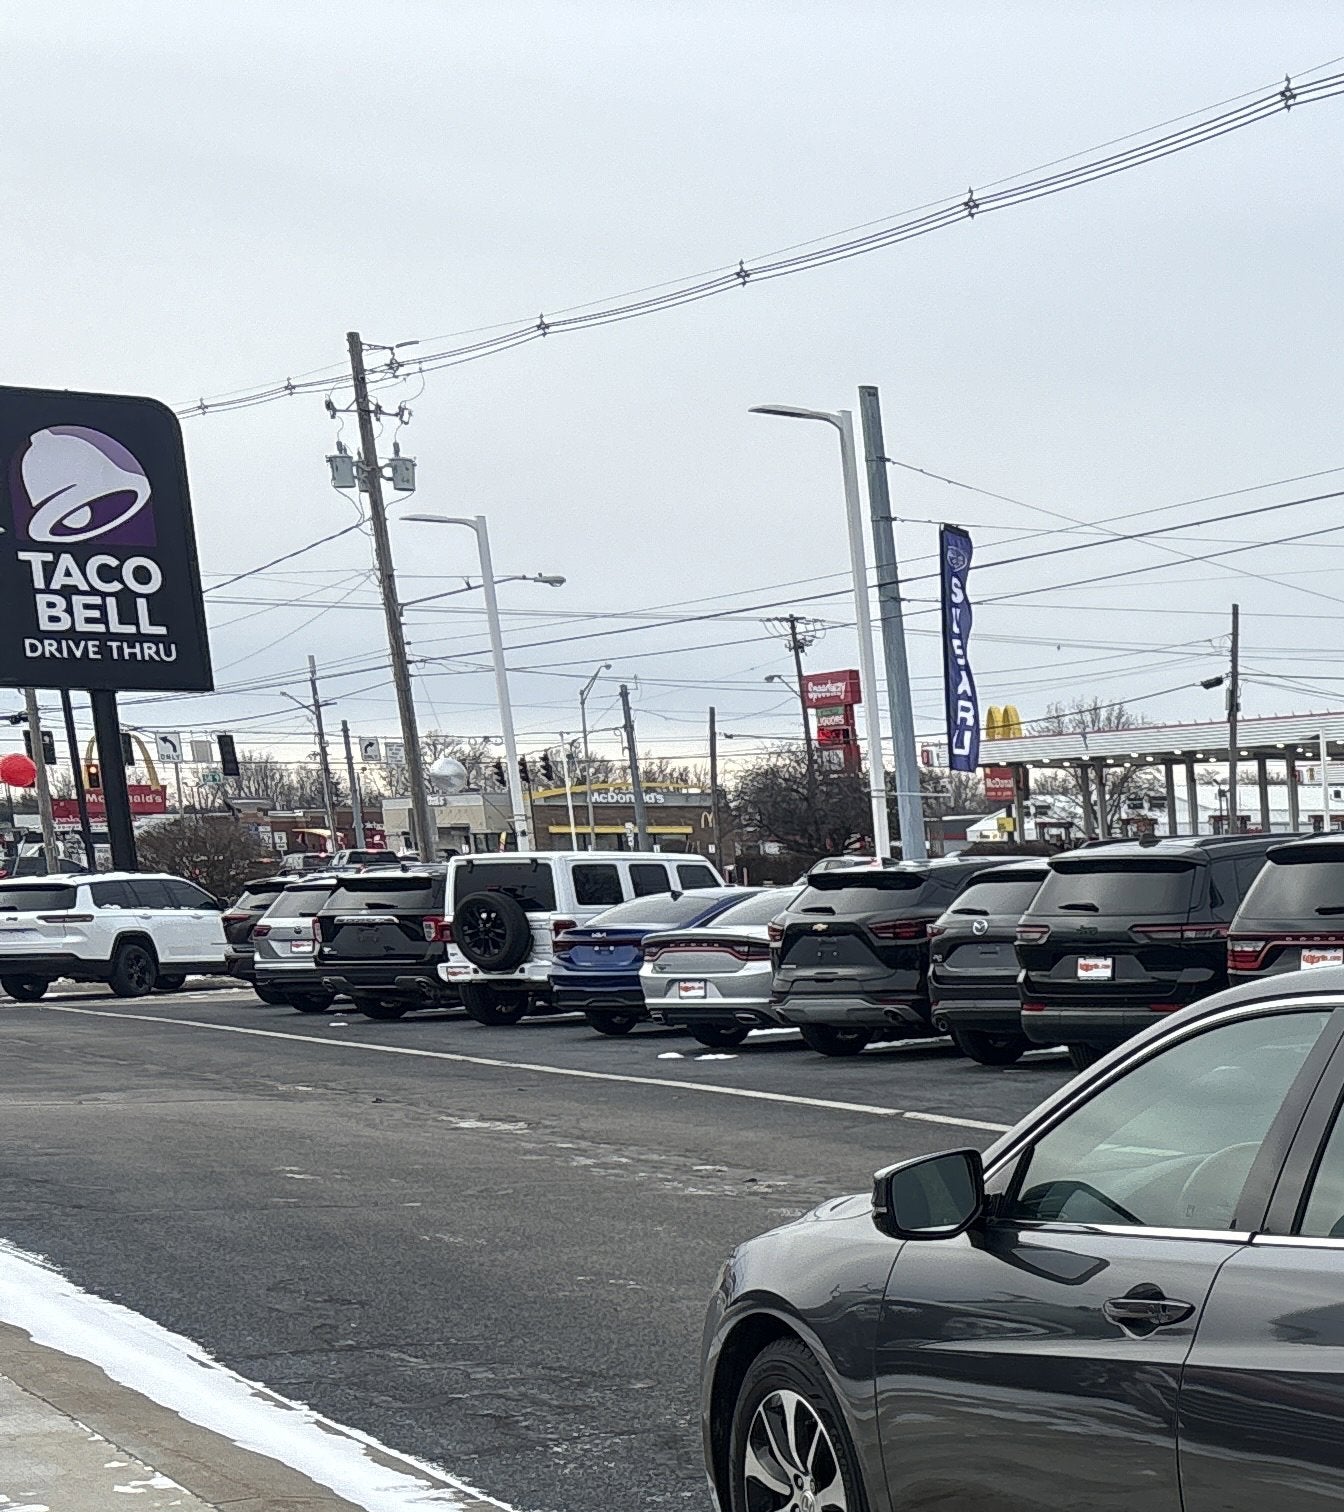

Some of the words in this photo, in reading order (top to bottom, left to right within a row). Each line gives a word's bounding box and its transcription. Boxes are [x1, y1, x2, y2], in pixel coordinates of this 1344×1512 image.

[17, 551, 163, 594] TACO
[35, 593, 168, 635] BELL
[23, 638, 102, 659] DRIVE
[106, 641, 178, 662] THRU
[160, 753, 181, 761] ONLY
[986, 777, 1014, 788] McDonal
[85, 793, 163, 803] Mcnald's
[591, 792, 665, 804] McDonld's
